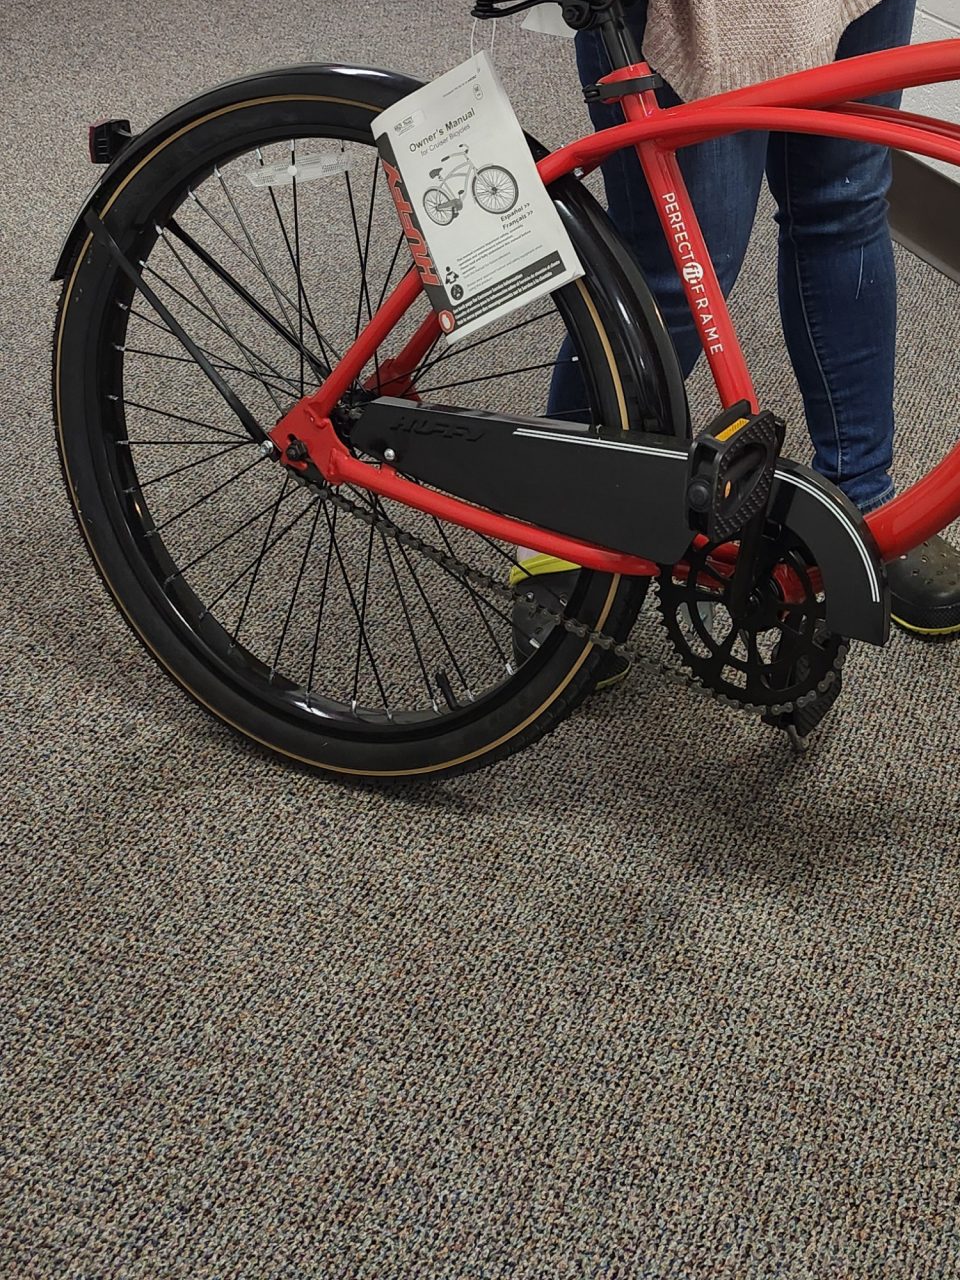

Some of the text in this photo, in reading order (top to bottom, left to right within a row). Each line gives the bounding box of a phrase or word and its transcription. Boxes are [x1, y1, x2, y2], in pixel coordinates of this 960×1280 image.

[409, 107, 476, 153] Owner's Manual
[382, 159, 442, 286] HUFFY
[662, 192, 695, 262] PERFECT
[691, 283, 724, 355] FRAME
